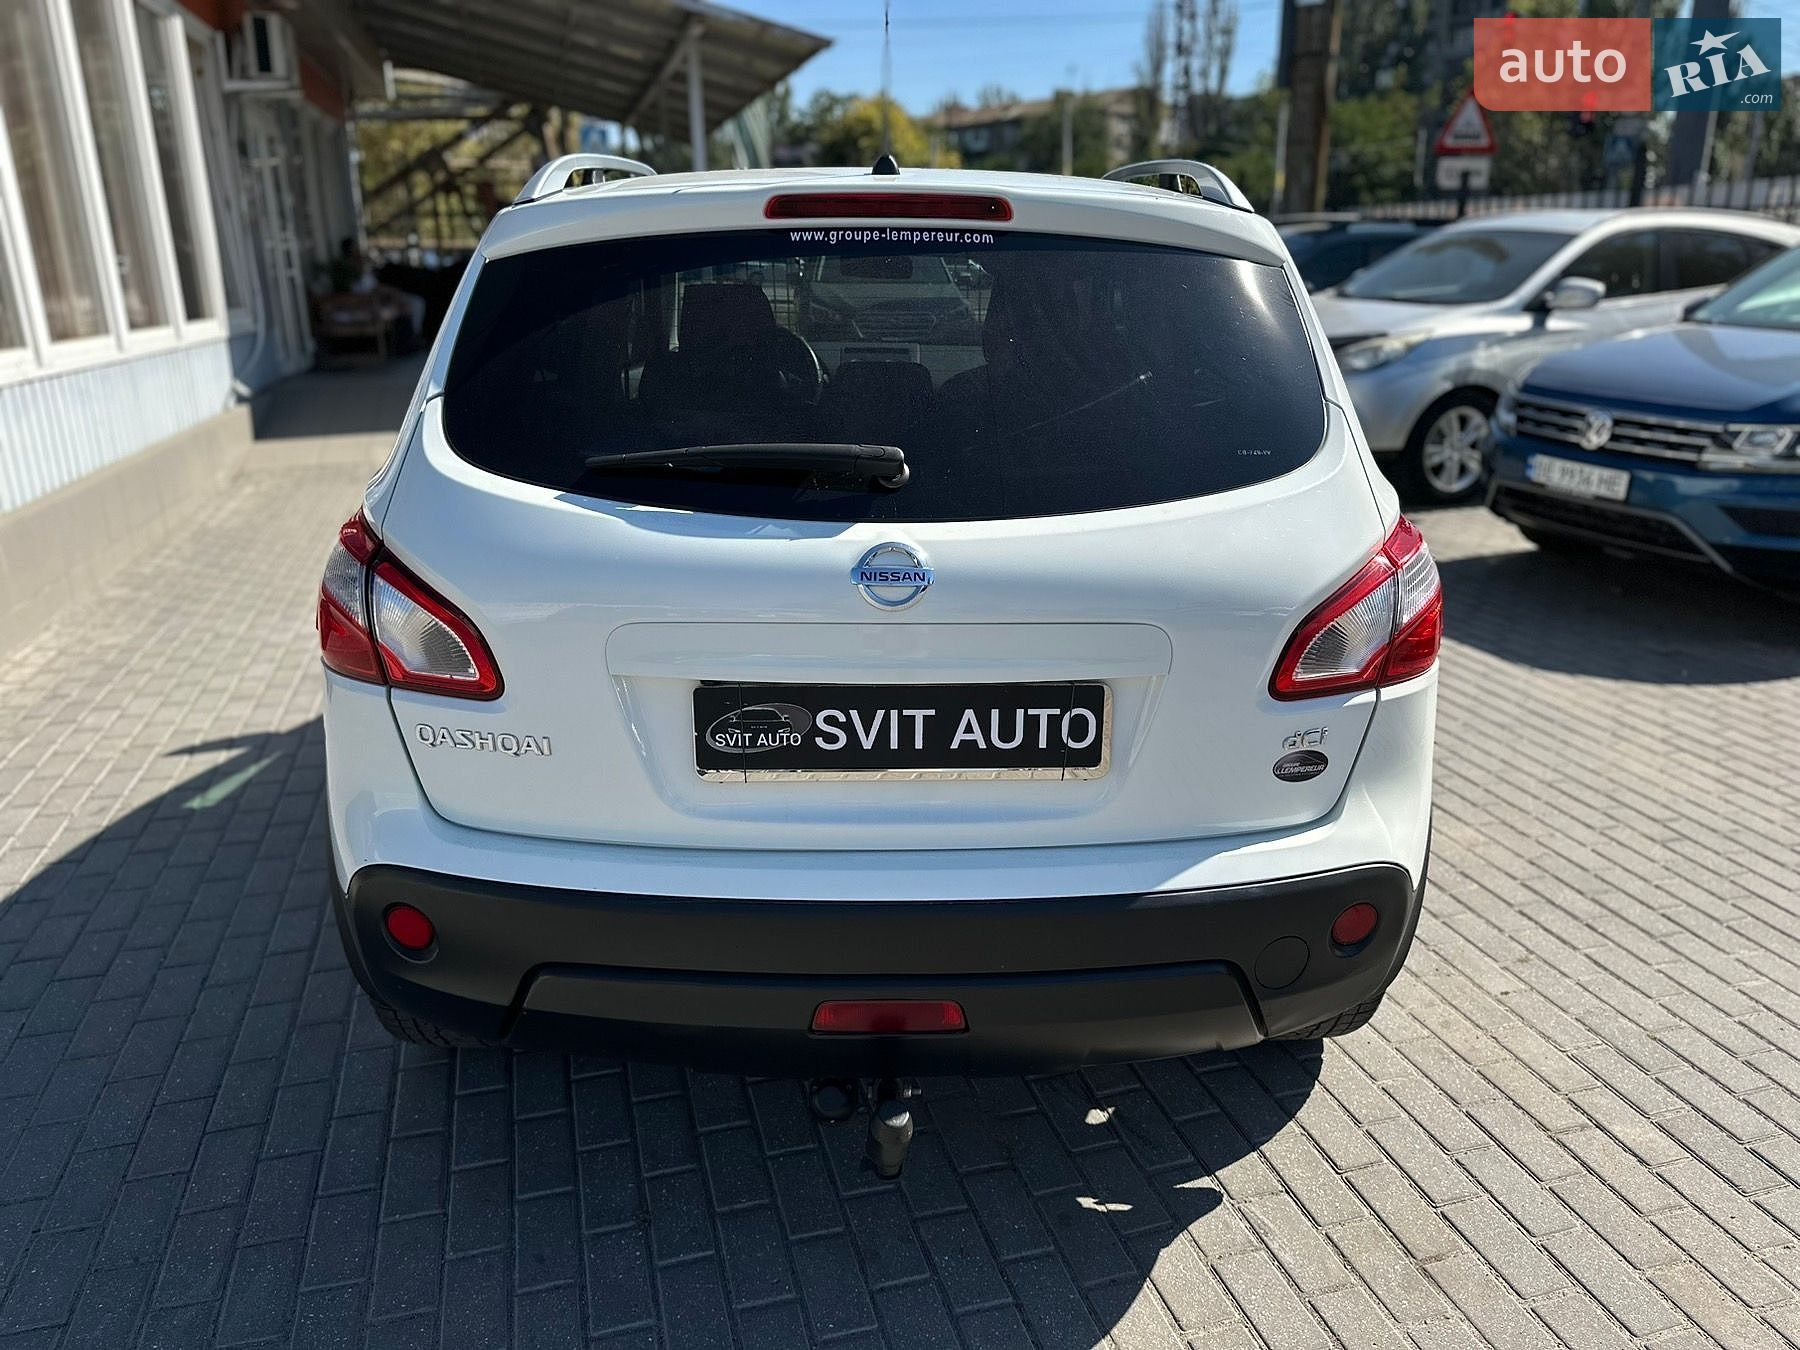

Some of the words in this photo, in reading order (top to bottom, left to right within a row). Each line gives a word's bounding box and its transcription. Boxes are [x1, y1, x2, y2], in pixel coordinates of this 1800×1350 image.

[790, 228, 994, 244] www.groupe-lempereur.com
[860, 571, 927, 582] NISSAN
[815, 709, 936, 751] SVIT
[950, 707, 1097, 750] AUTO
[415, 723, 552, 756] QASHQAI
[715, 733, 752, 747] SVIT
[756, 733, 802, 747] AUTO
